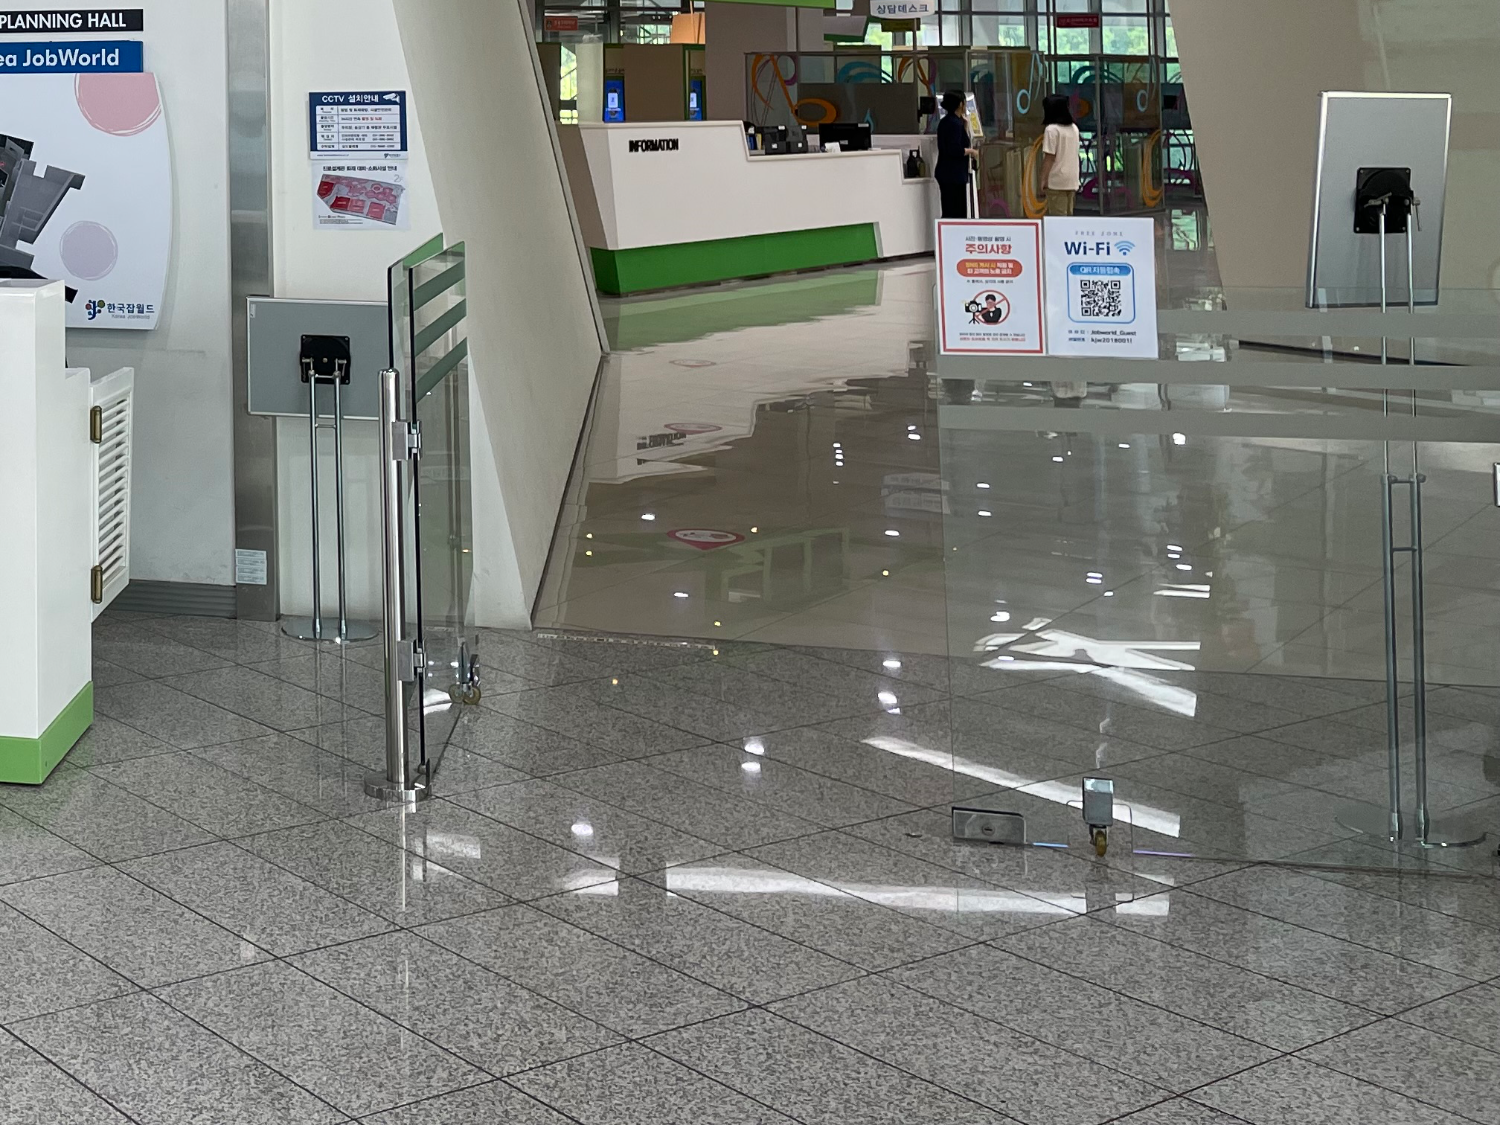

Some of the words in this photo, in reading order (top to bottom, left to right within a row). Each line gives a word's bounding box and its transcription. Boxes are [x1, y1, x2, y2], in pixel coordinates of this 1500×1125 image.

[876, 4, 929, 14] 상담데스크
[87, 12, 126, 28] HALL
[22, 48, 120, 67] JobWorld
[322, 95, 345, 103] CCTV
[348, 94, 379, 103] 설치안내
[629, 138, 678, 153] INFORMATION
[965, 243, 1012, 254] 주의사항
[1064, 241, 1110, 256] Wi-Fi
[107, 303, 155, 314] 한국잡월드
